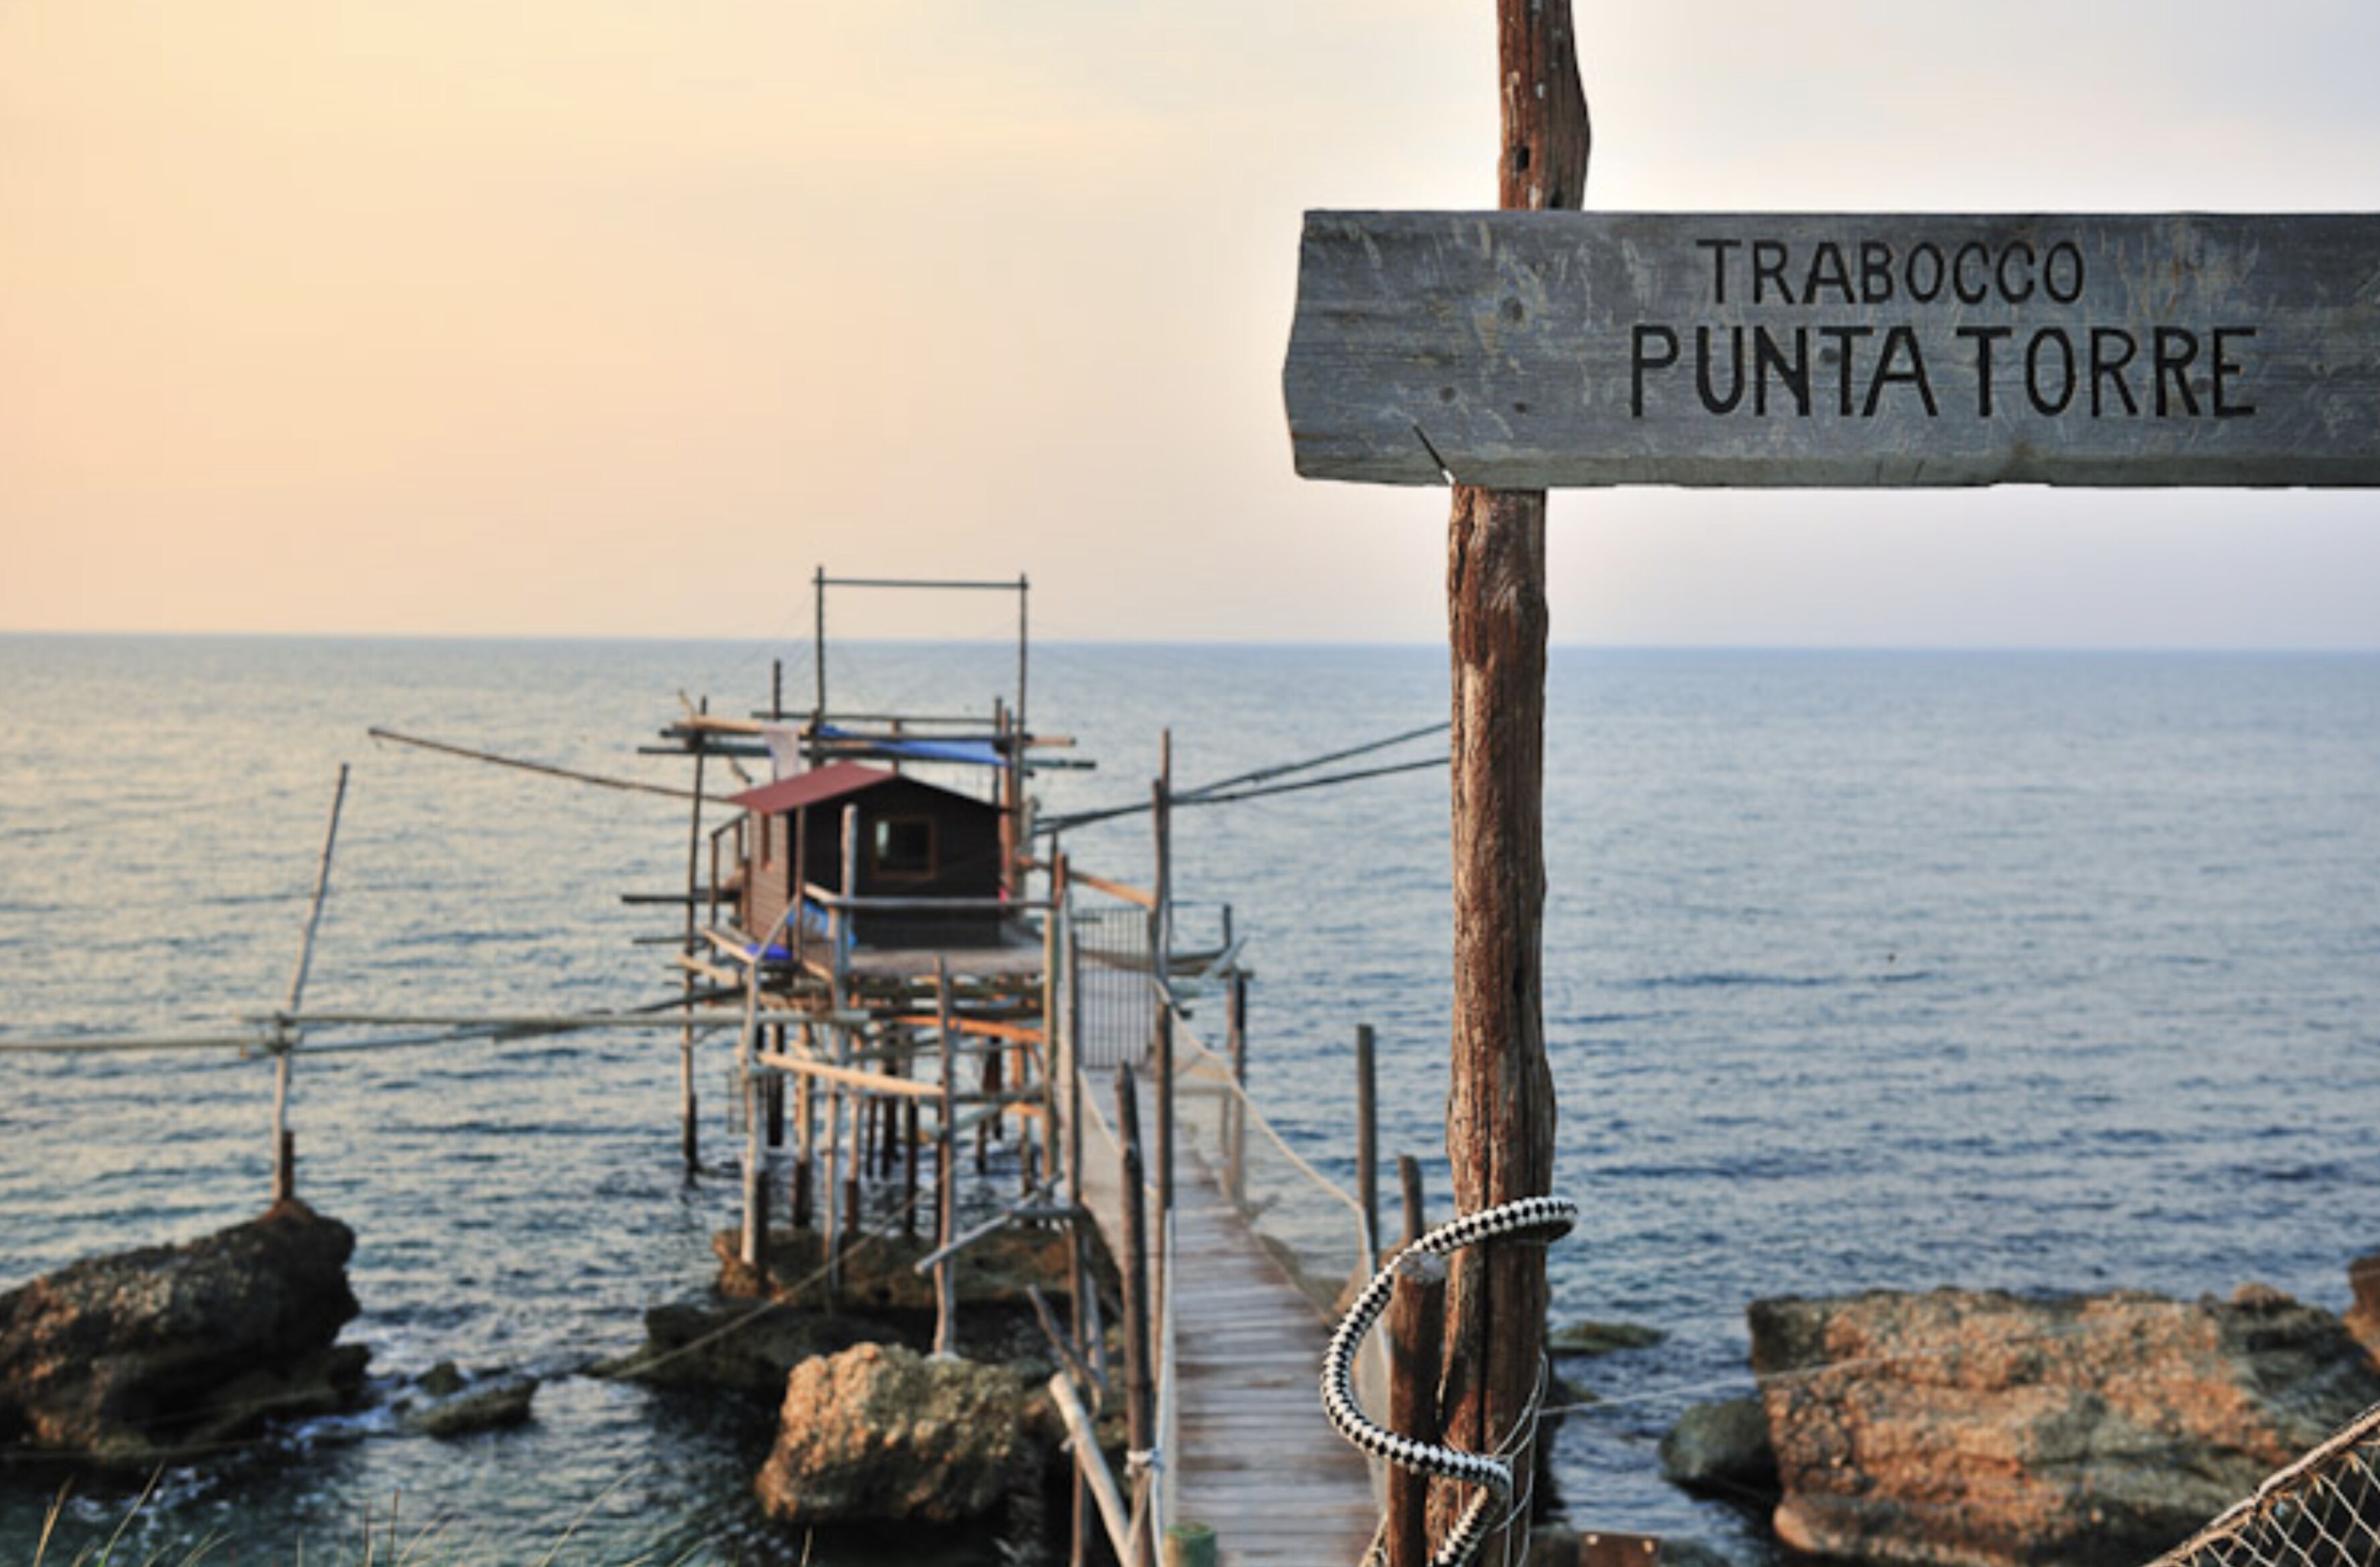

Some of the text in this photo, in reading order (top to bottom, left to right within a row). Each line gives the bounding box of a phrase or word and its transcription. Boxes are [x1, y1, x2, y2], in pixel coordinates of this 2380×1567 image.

[1695, 239, 2085, 304] TRABOCCO
[1630, 325, 2257, 418] PUNTA TORRE
